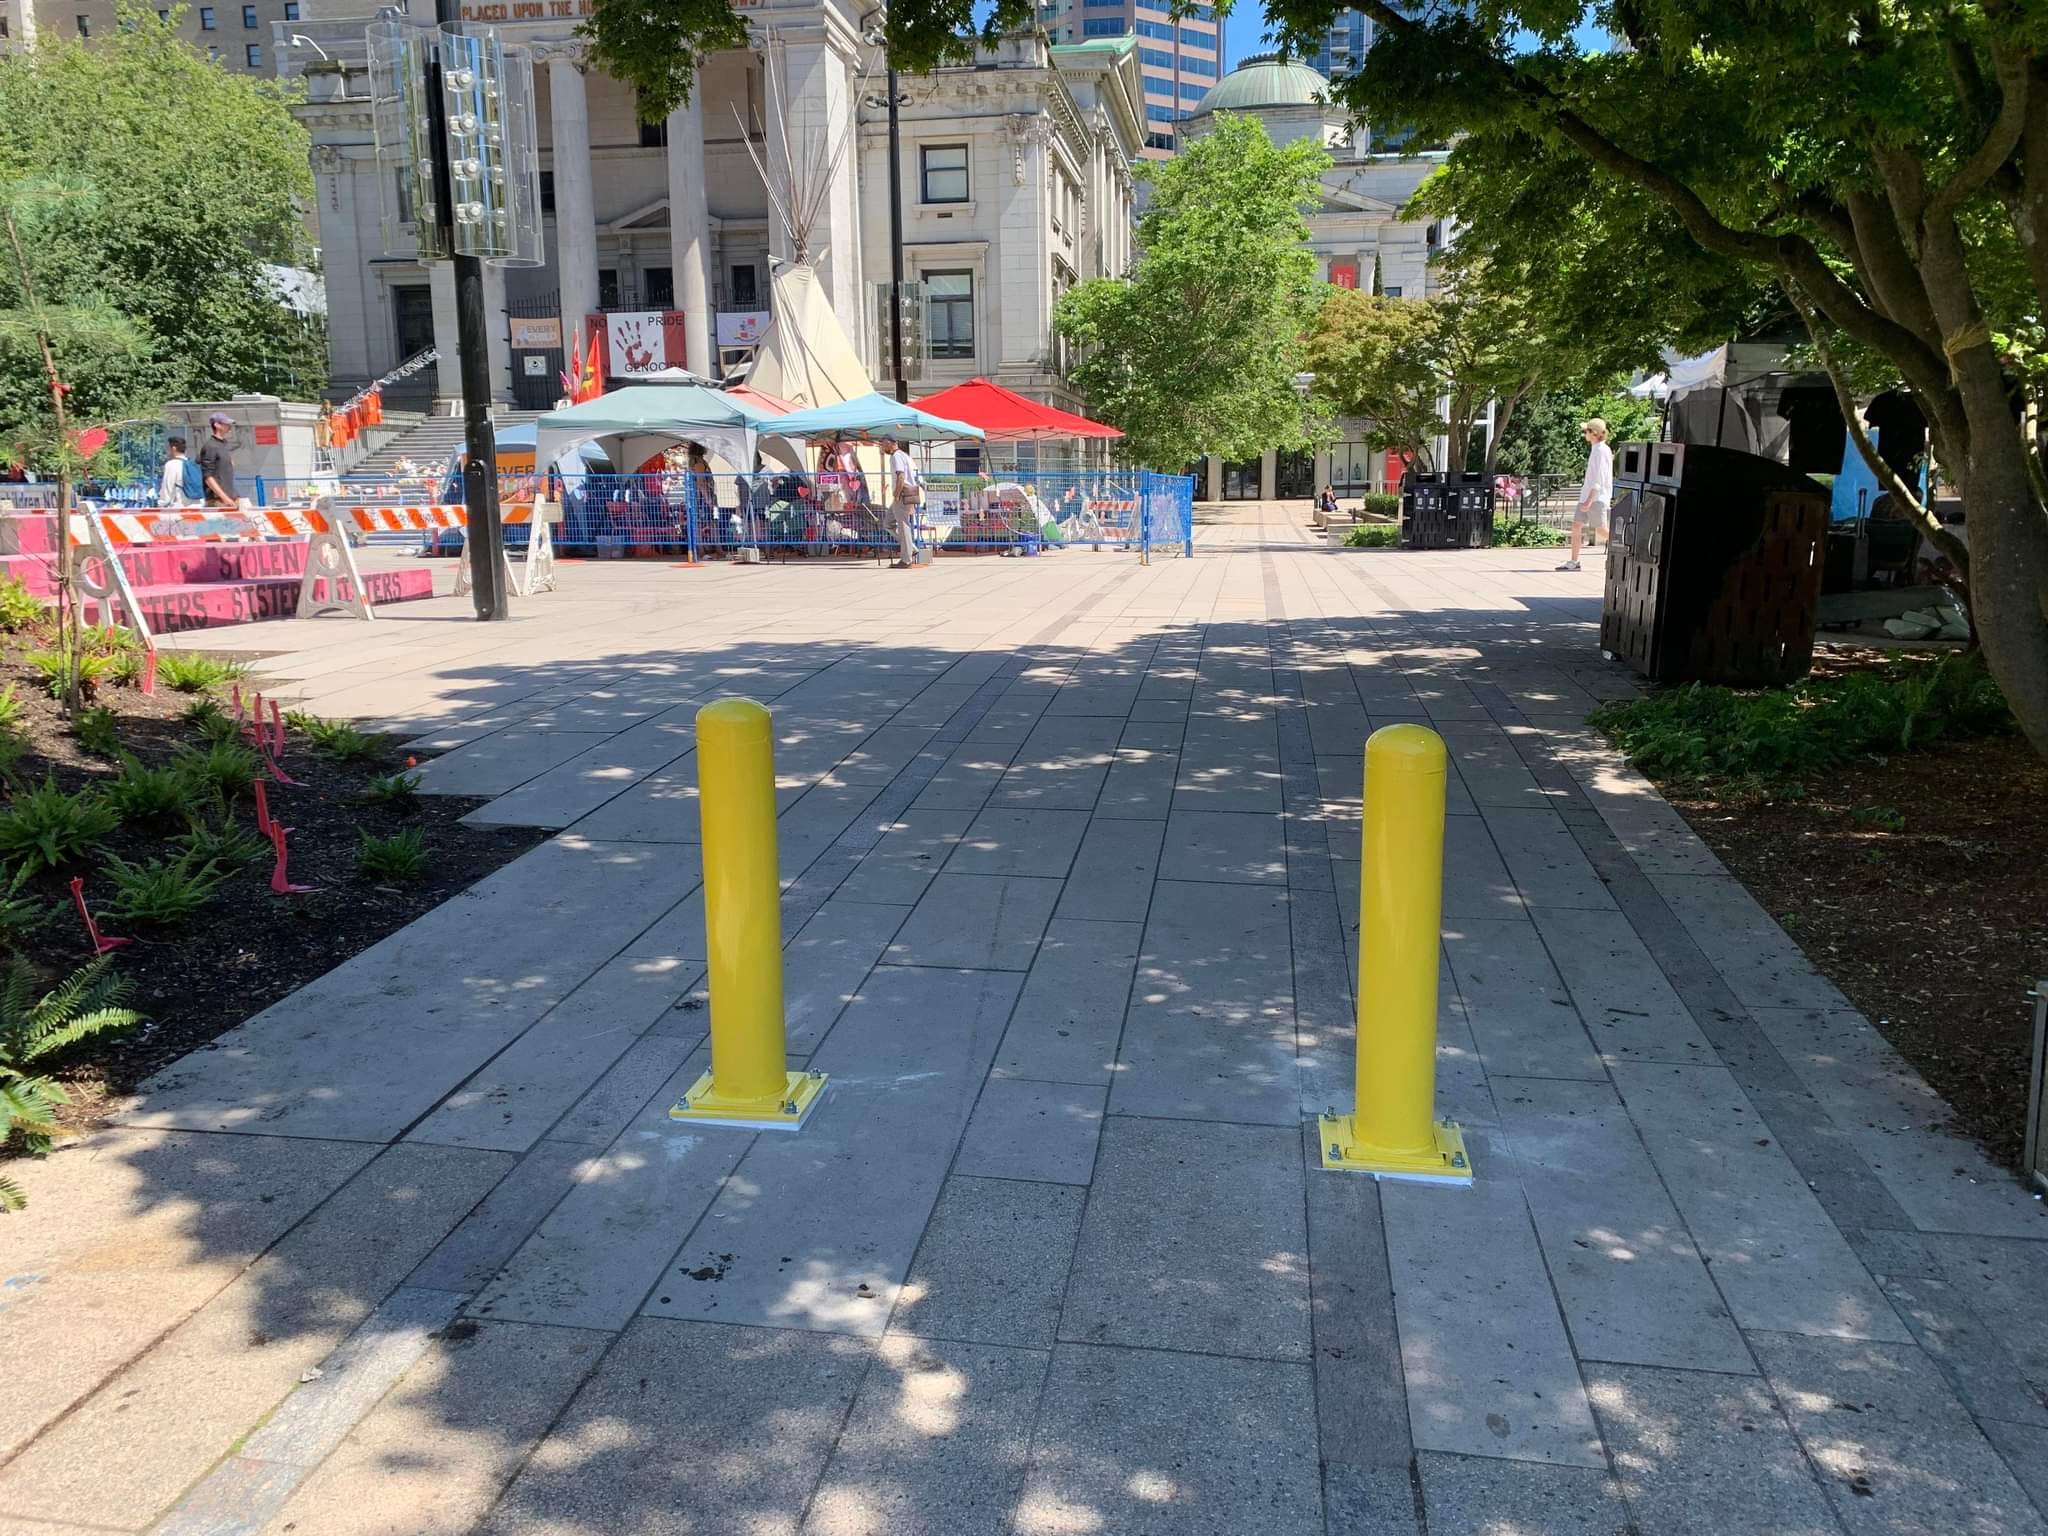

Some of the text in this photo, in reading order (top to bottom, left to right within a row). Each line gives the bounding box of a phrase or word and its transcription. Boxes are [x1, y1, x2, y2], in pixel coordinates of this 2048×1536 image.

[462, 4, 507, 20] PLACED
[513, 2, 544, 18] UPON
[549, 1, 573, 16] THE
[648, 315, 684, 327] PRIDE
[219, 543, 300, 580] STOLEN
[232, 581, 302, 621] SISTER
